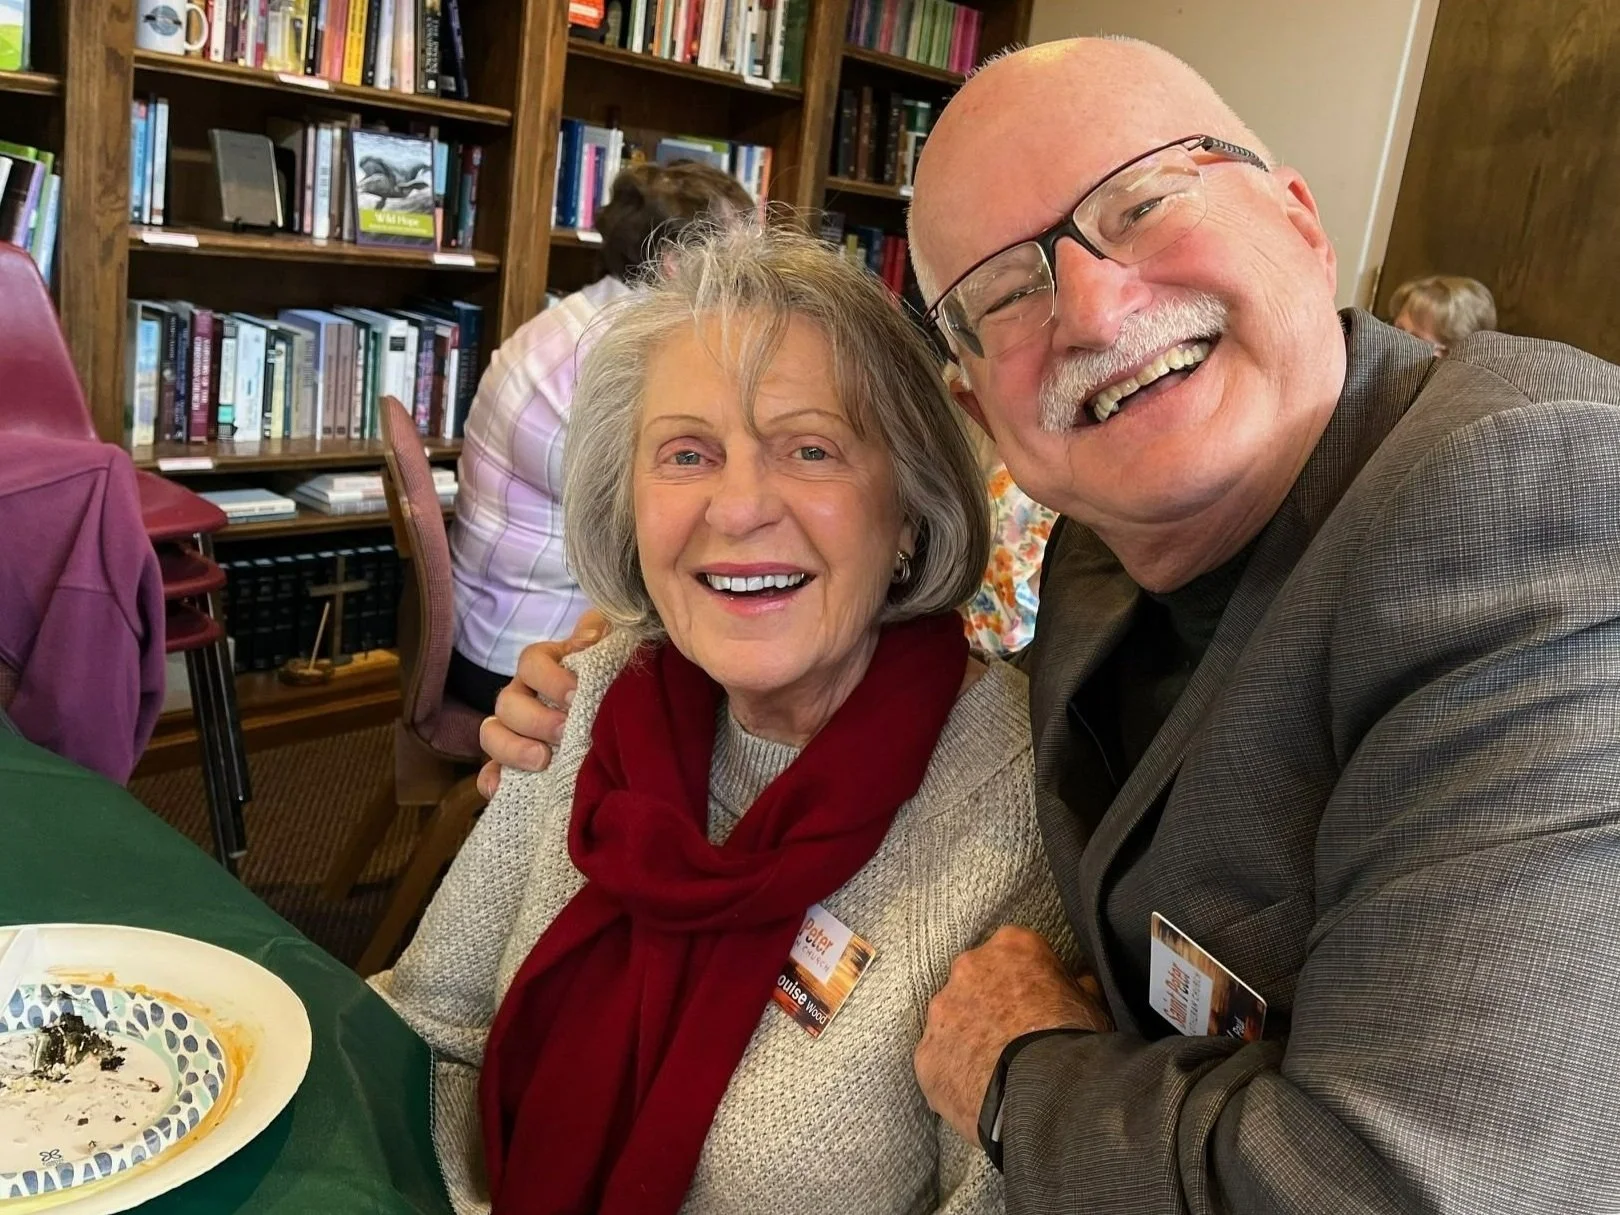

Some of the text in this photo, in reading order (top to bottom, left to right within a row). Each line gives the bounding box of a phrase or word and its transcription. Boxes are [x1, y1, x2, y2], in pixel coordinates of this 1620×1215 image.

[375, 211, 419, 228] Wild Hope
[799, 917, 834, 955] Peter
[802, 945, 831, 972] CHURCH
[777, 974, 828, 1025] ouise Wood
[1163, 962, 1190, 1030] Saint Peter
